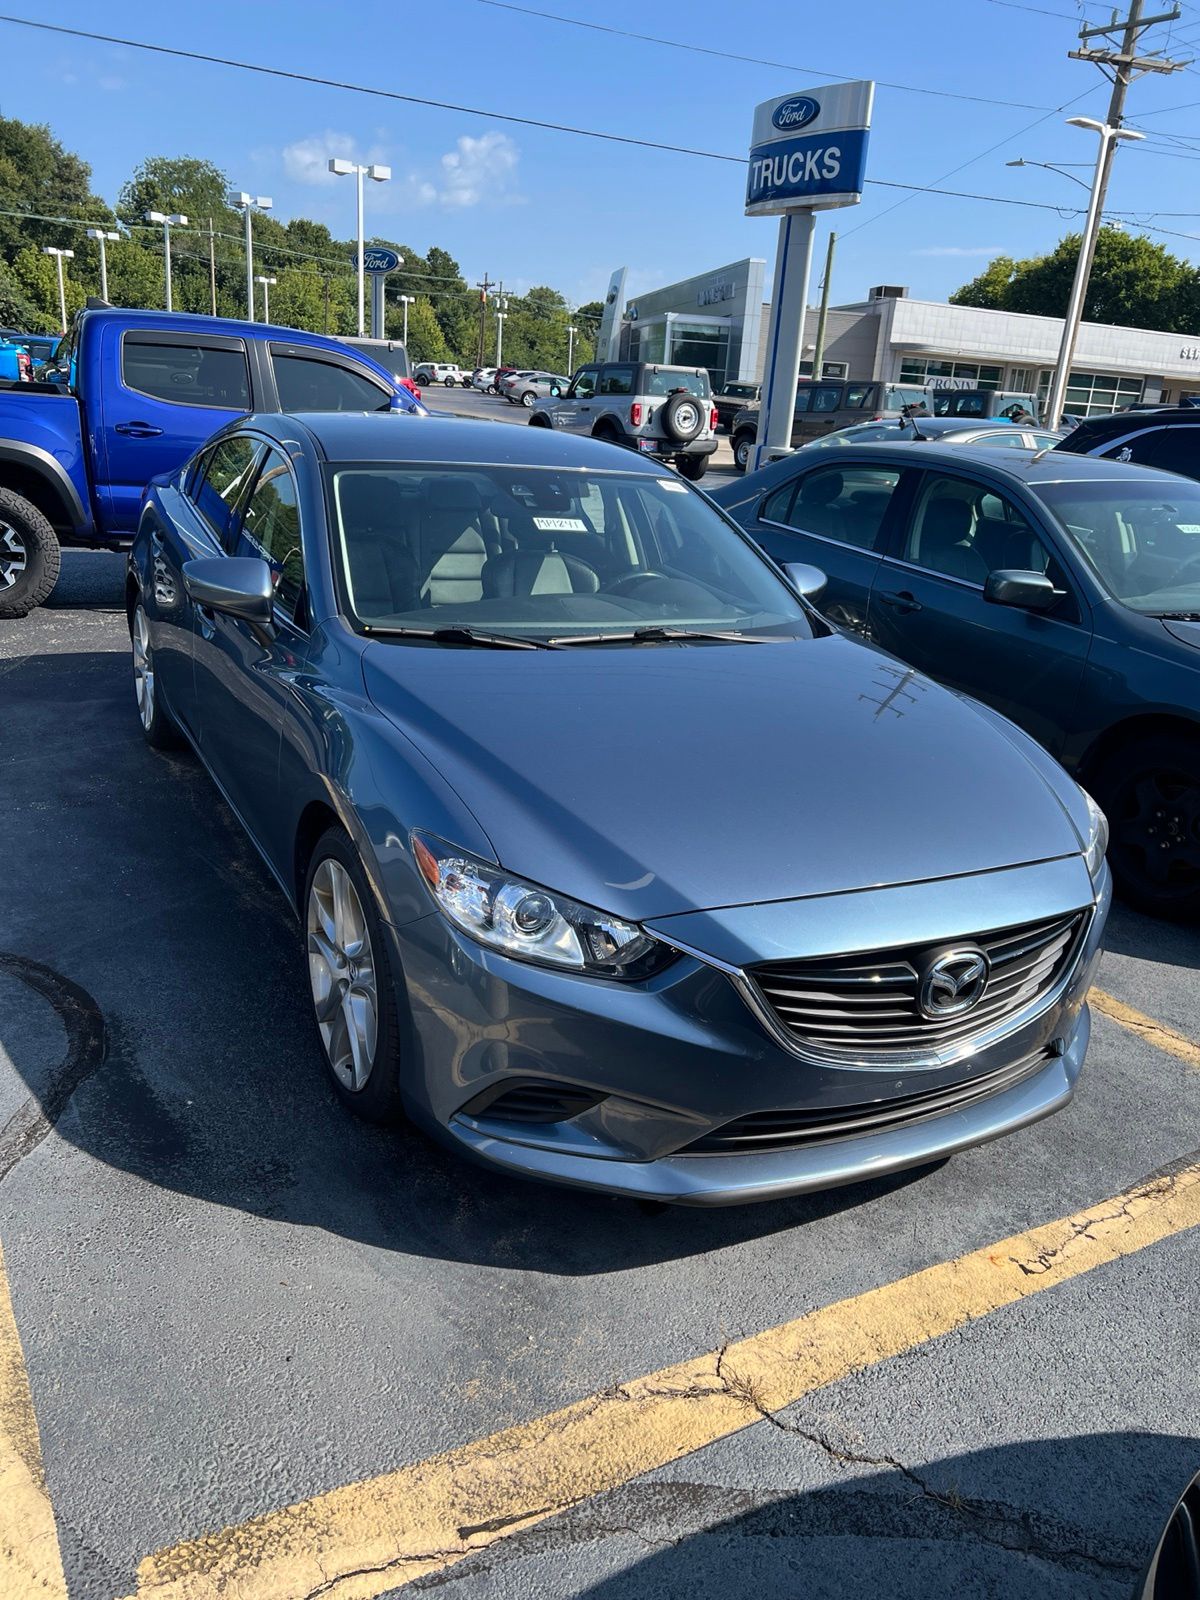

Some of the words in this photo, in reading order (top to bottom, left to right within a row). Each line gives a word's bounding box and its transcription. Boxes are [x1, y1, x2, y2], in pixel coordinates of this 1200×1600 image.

[778, 102, 807, 125] Ford
[752, 146, 841, 190] TRUCKS
[363, 252, 390, 269] Ford
